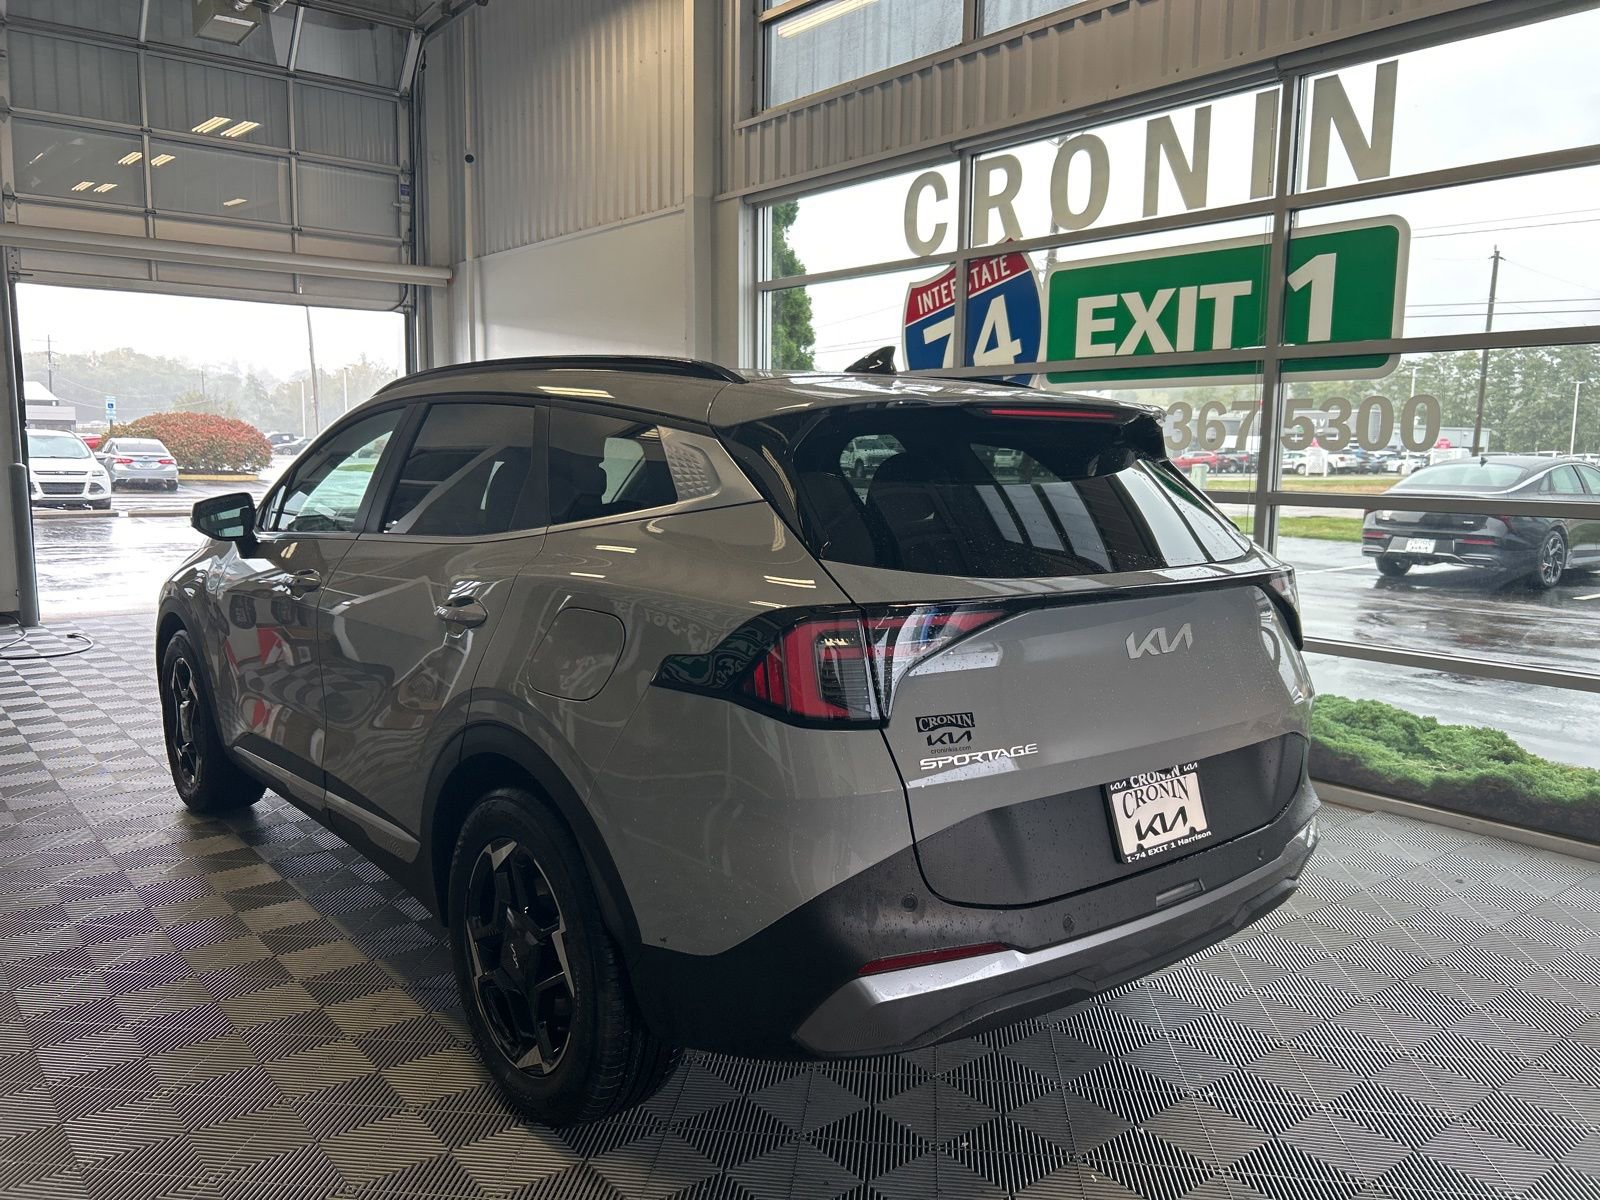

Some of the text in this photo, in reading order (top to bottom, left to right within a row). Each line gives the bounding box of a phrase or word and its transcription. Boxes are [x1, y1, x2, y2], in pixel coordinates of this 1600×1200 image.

[904, 59, 1399, 256] CRONIN
[1075, 253, 1337, 358] EXIT 1
[923, 294, 1022, 368] 74
[1125, 623, 1193, 659] KIA
[918, 713, 973, 731] CRONIN
[926, 730, 972, 746] KIA
[920, 743, 1038, 770] SPORTAGE
[930, 745, 971, 754] croninkia.com
[1122, 776, 1189, 819] CRONIN
[1134, 805, 1188, 841] KIA
[1126, 830, 1212, 863] I-74 EXIT 1 Harrison
